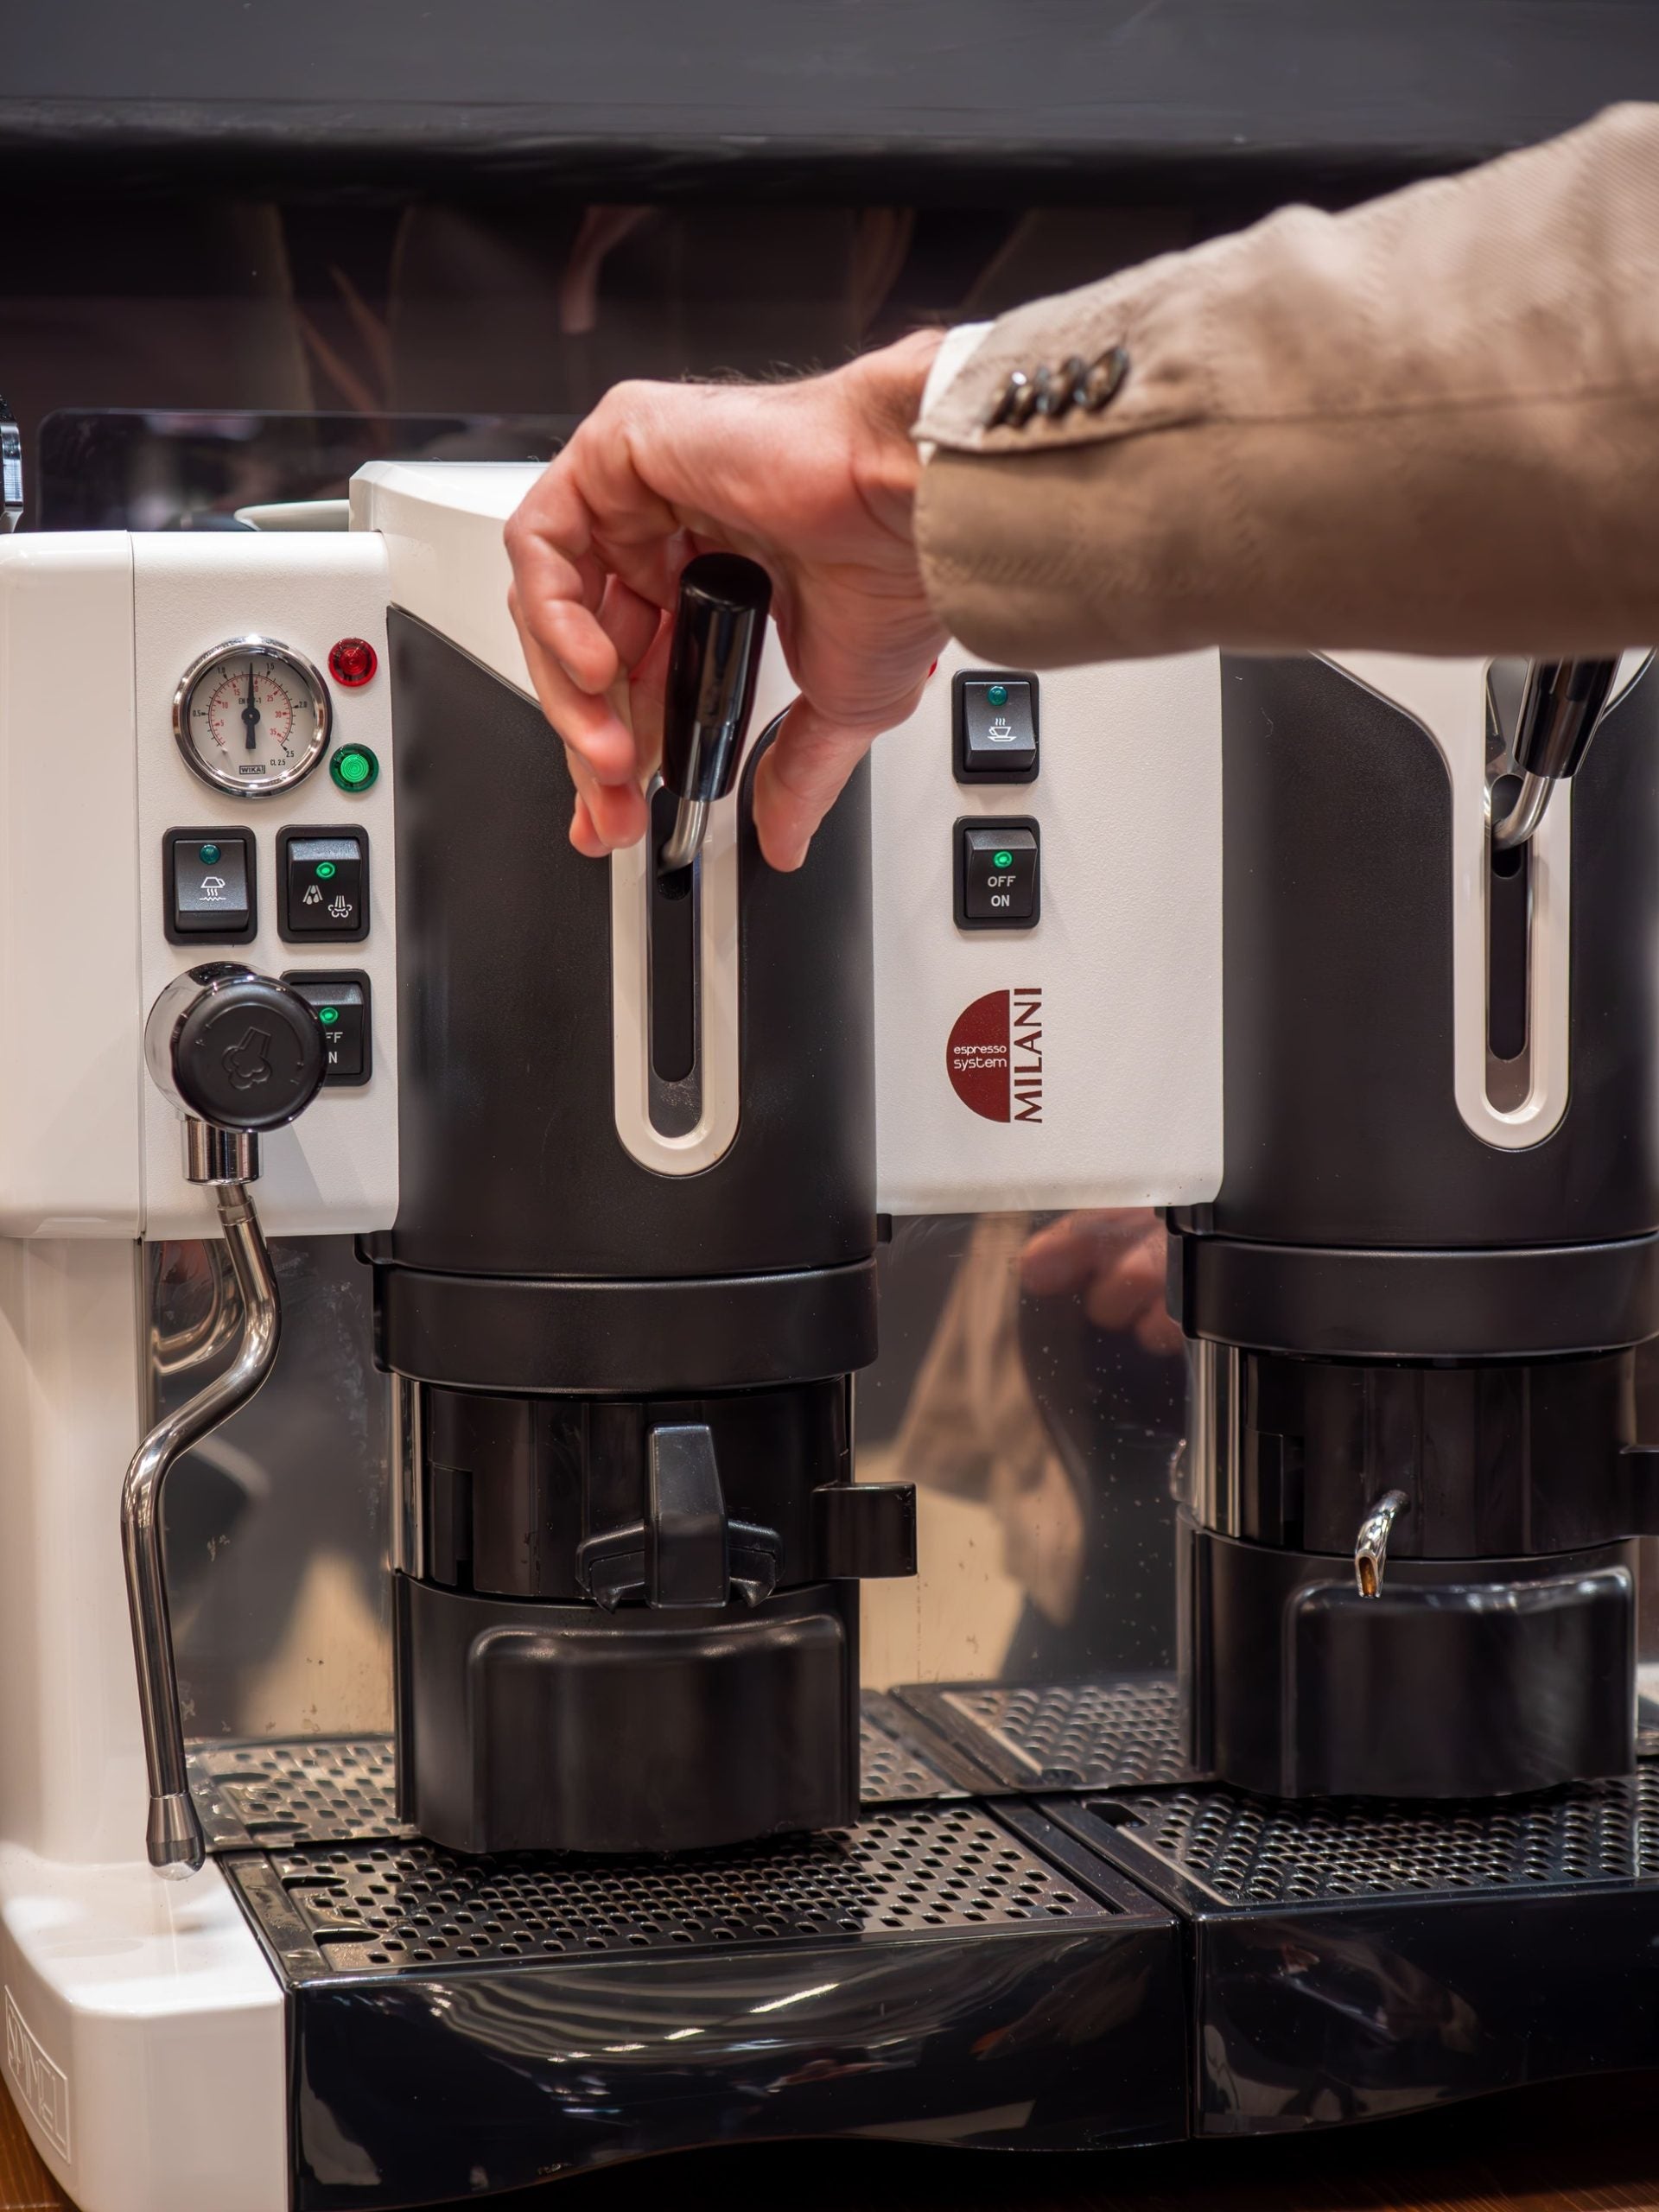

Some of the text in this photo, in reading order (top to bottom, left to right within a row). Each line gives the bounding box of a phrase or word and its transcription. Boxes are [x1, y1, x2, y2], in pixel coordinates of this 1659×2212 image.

[987, 875, 1016, 888] OFF
[990, 894, 1010, 907] ON
[326, 1032, 343, 1043] FF
[953, 1045, 1007, 1056] espresso
[1014, 988, 1043, 1123] MILANI
[328, 1052, 337, 1064] N
[953, 1057, 1007, 1071] system
